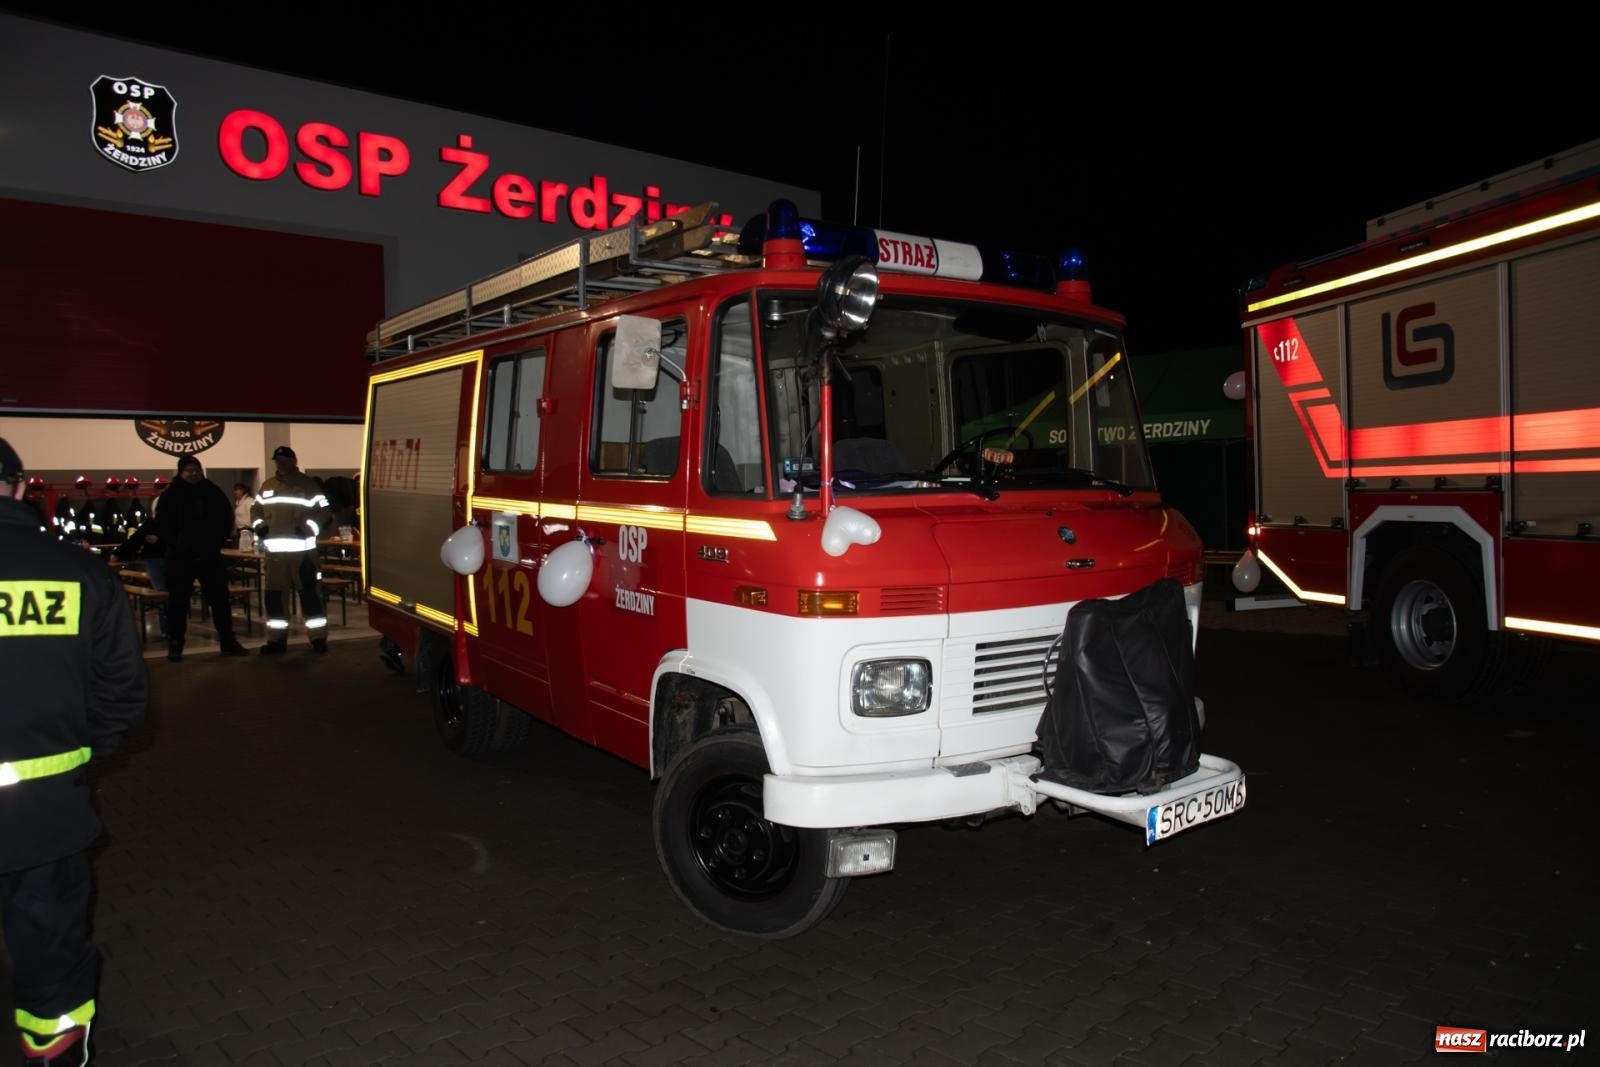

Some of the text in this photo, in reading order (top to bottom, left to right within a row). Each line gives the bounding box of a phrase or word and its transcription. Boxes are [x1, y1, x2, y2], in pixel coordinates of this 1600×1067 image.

[112, 81, 155, 99] OSP
[102, 143, 168, 167] ŻERDZINY
[217, 109, 734, 240] OSP Żerdzi
[879, 238, 936, 269] STRAŻ
[146, 431, 215, 453] ŻERDZINY
[1049, 426, 1126, 444] SOTWO
[618, 524, 648, 564] OSP
[483, 563, 533, 637] 112
[614, 585, 655, 616] ŻERDZINY
[1160, 797, 1198, 835] SRC
